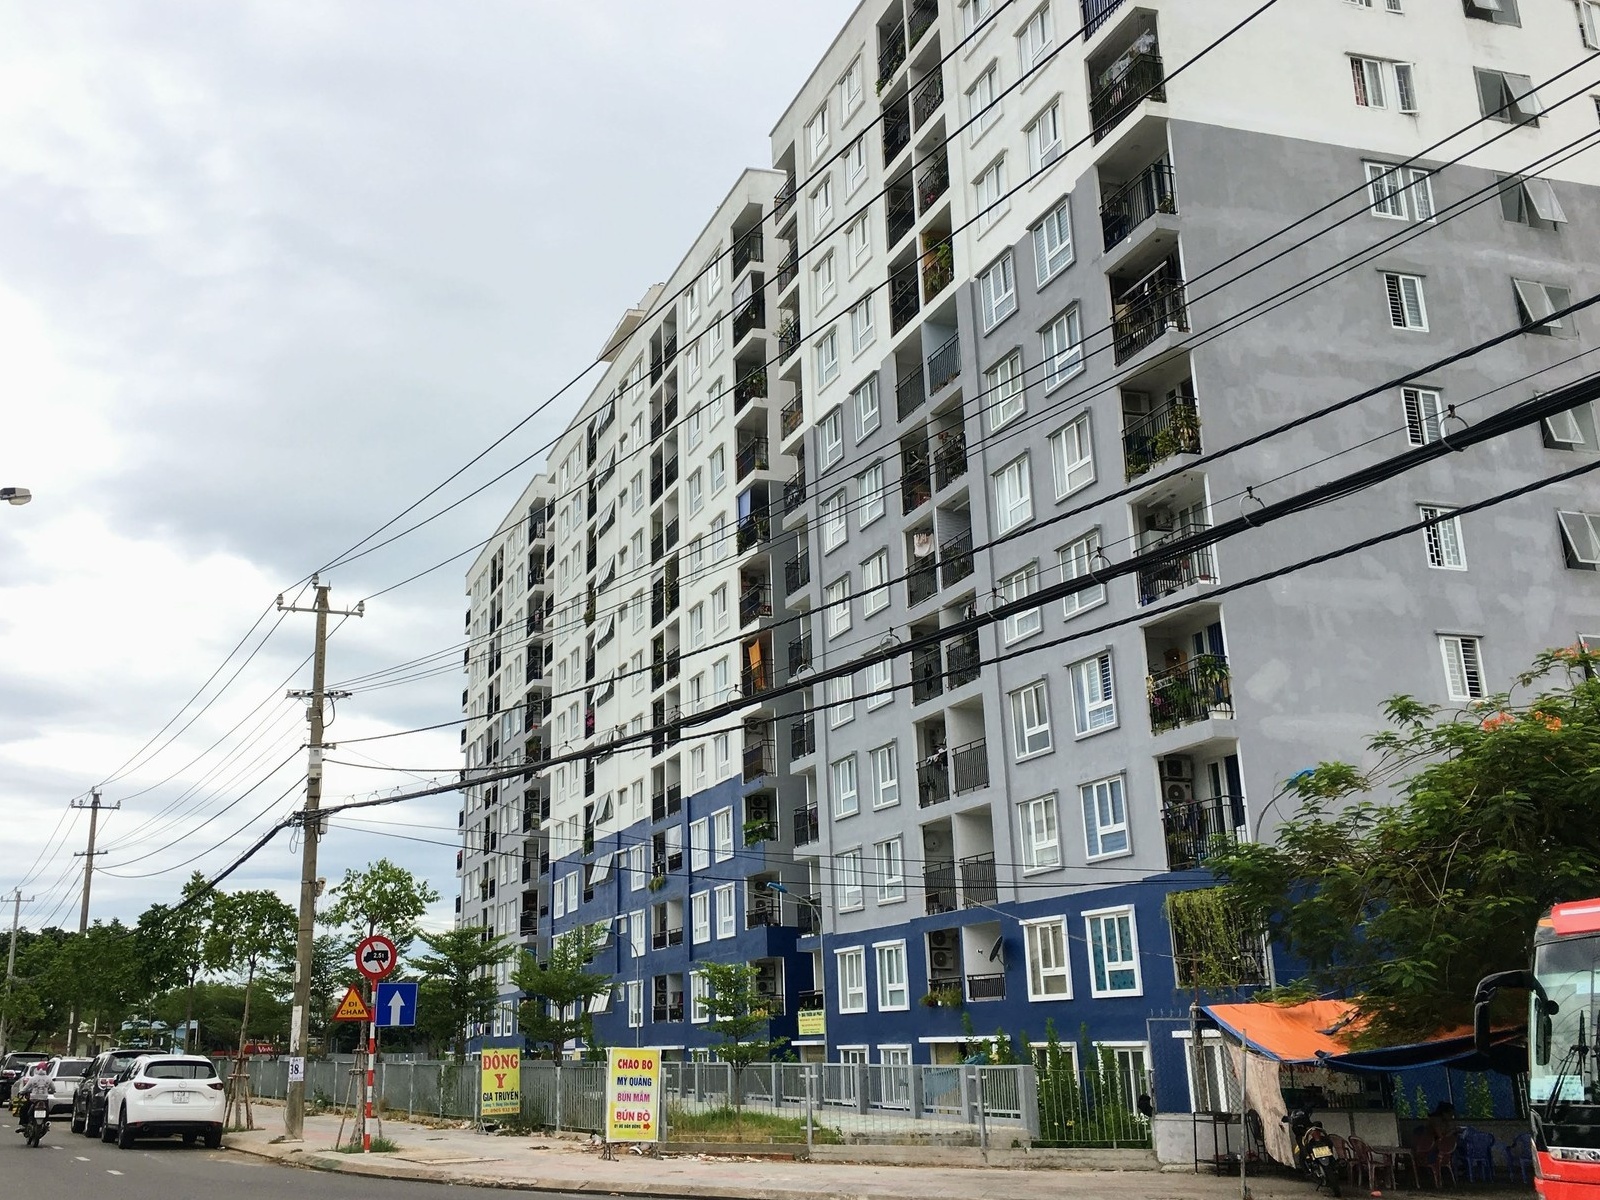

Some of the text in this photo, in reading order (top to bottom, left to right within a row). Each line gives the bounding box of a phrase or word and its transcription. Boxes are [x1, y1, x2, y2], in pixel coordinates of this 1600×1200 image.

[483, 1050, 519, 1070] ĐÔNG
[290, 1064, 300, 1075] 38
[494, 1073, 507, 1089] Y
[483, 1092, 494, 1102] GIA
[616, 1109, 651, 1122] BÚN BÒ
